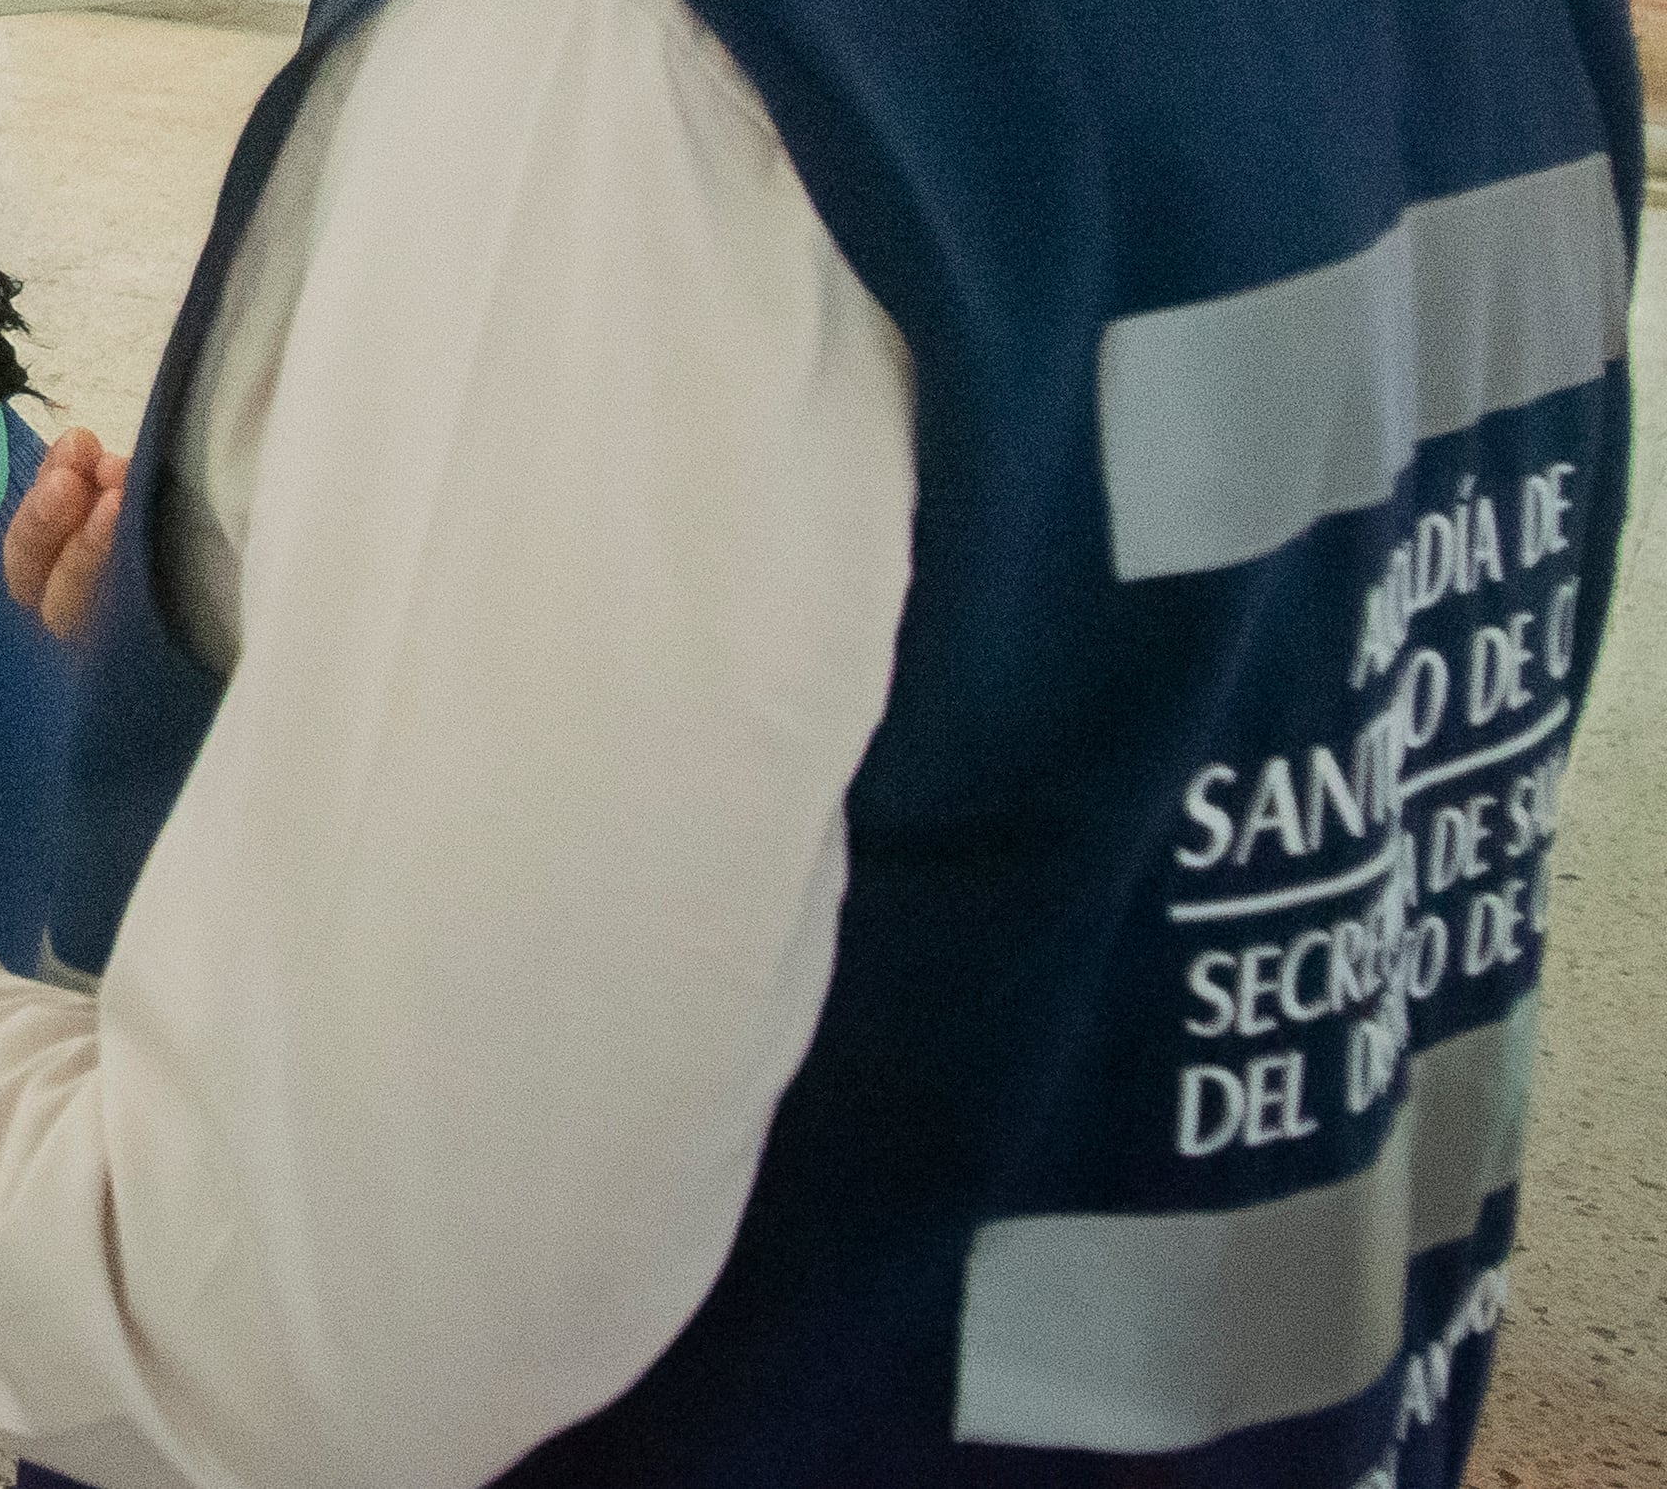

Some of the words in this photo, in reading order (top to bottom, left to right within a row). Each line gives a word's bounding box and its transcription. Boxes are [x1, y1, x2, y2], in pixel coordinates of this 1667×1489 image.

[1518, 461, 1576, 568] DE
[1467, 609, 1534, 727] DE
[1426, 792, 1499, 894] DE
[1174, 1050, 1319, 1159] DEL
[1462, 878, 1526, 978] DE
